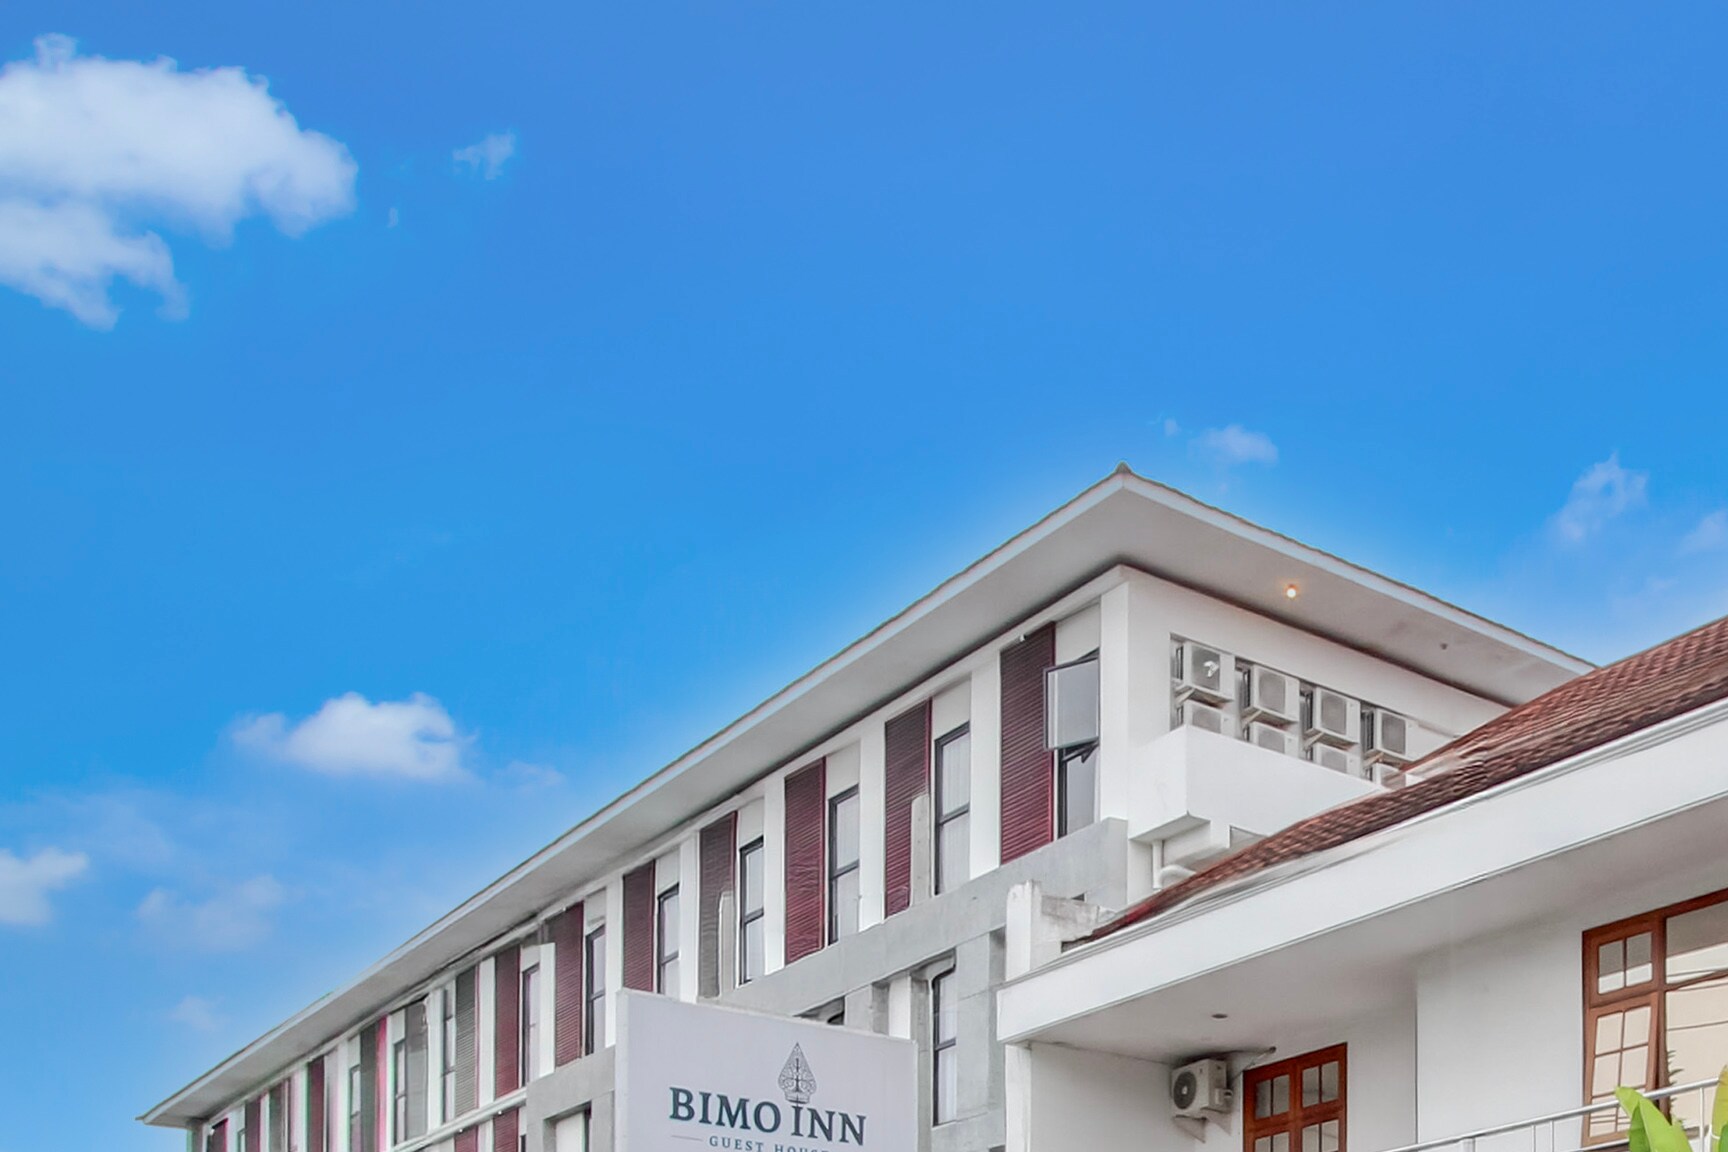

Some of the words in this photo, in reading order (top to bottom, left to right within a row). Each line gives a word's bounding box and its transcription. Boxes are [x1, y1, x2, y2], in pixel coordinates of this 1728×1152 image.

[669, 1086, 781, 1133] BIMO
[791, 1104, 867, 1146] INN
[709, 1135, 764, 1152] GUEST
